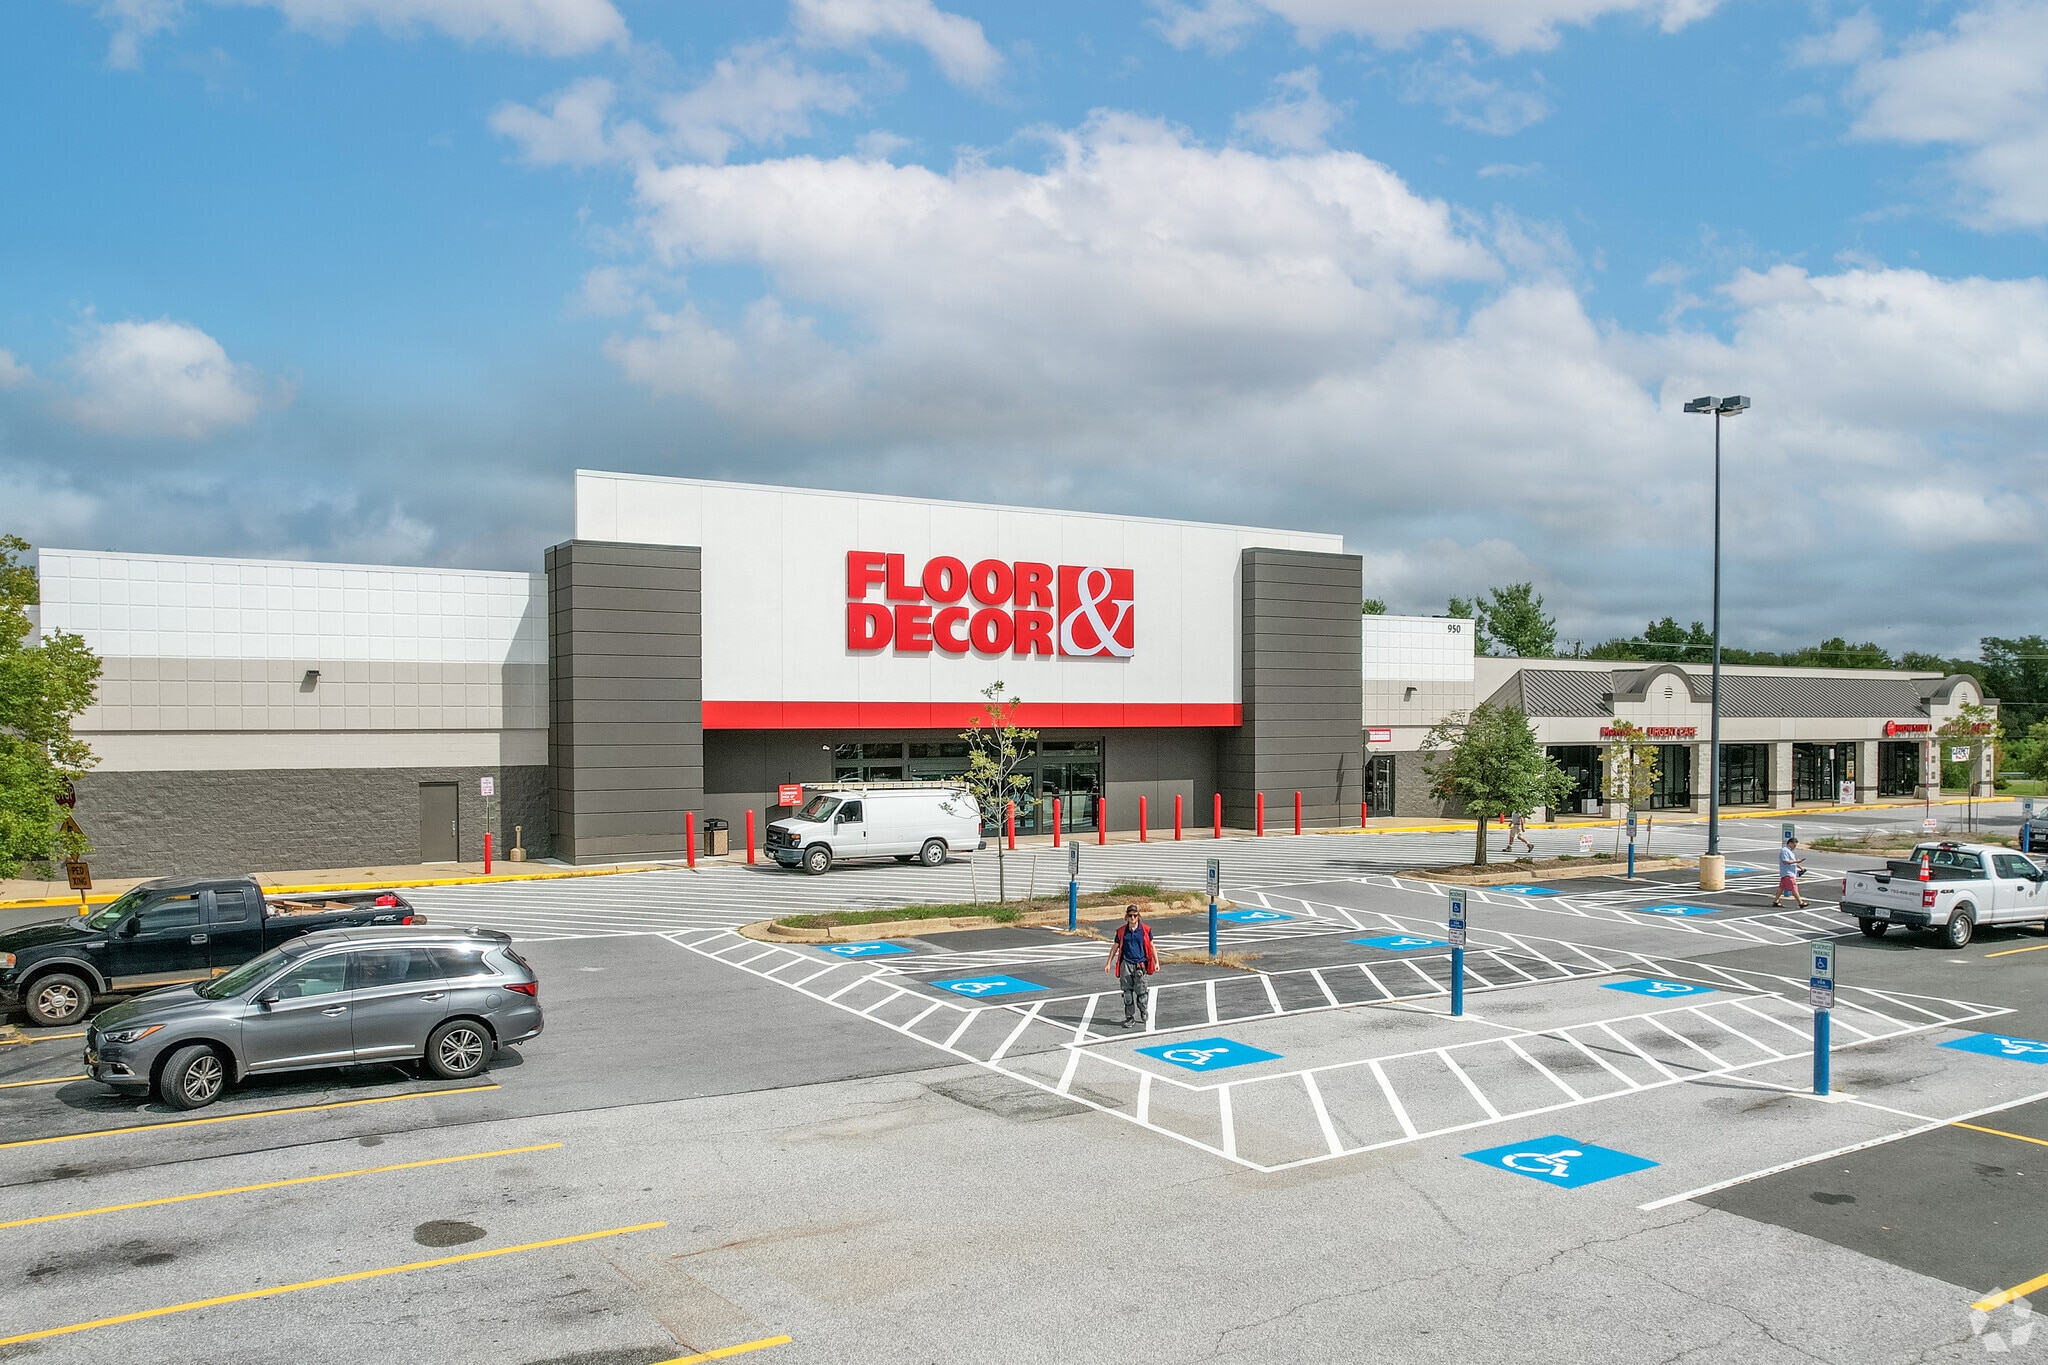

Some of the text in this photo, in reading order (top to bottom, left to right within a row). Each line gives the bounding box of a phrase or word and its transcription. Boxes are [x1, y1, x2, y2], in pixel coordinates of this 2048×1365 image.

[847, 550, 1135, 657] FLOOR &
[847, 602, 1055, 655] DECOR
[1447, 624, 1461, 633] 950
[1648, 727, 1677, 737] URGENT
[1678, 727, 1698, 737] CARE
[71, 866, 84, 875] PED
[72, 877, 87, 885] XING
